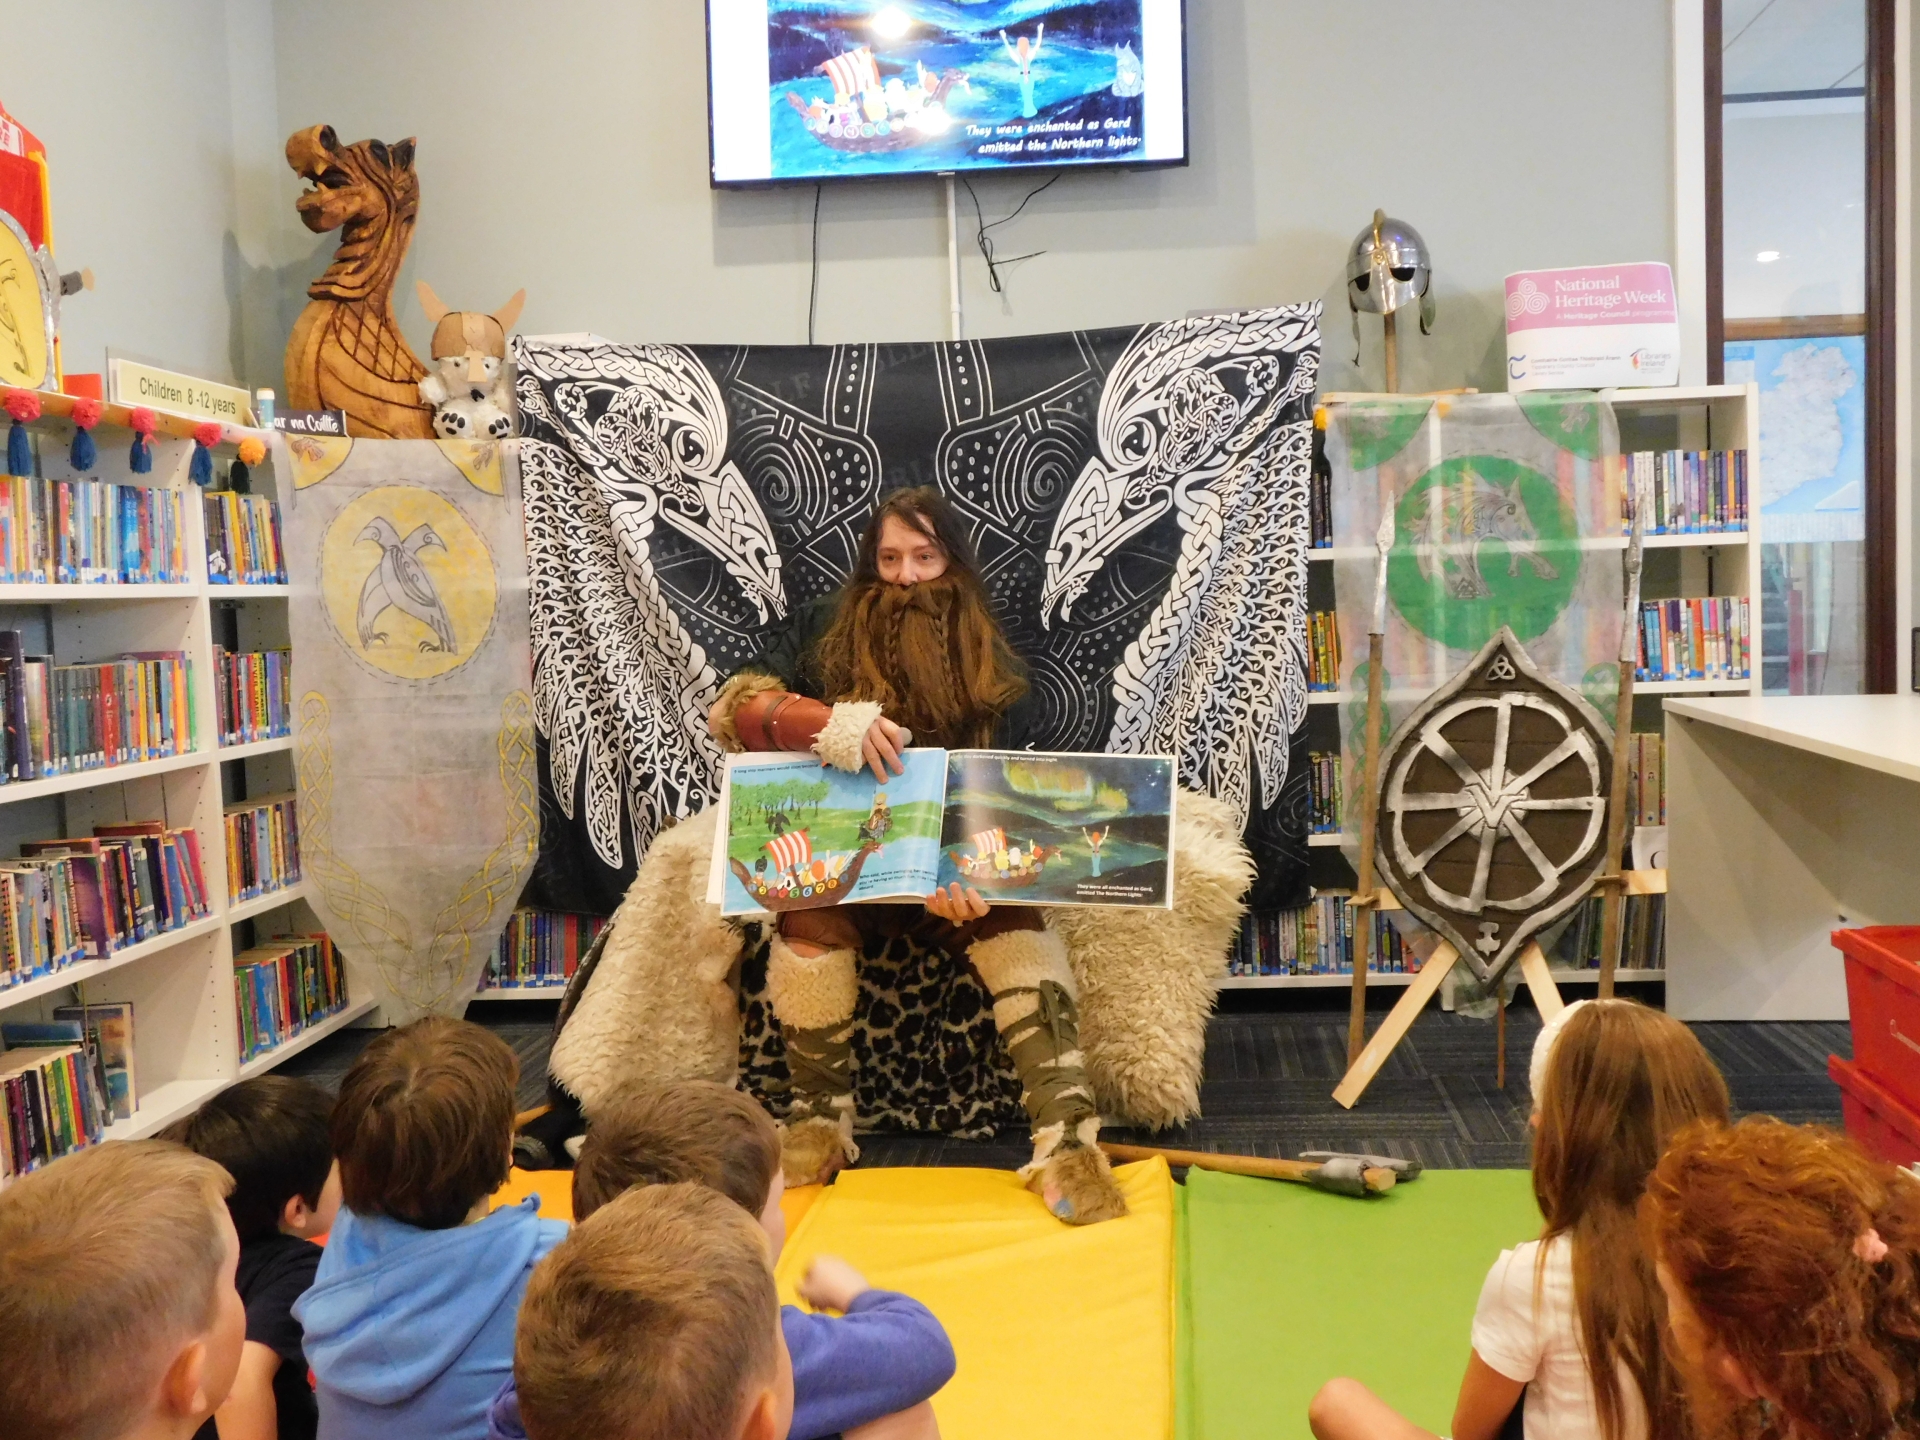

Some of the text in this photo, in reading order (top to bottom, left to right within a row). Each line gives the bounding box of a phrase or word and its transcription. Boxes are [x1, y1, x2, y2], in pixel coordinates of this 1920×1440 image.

[965, 116, 1131, 138] They were enchanted as Gerd
[978, 140, 1023, 154] emitted
[1027, 139, 1047, 151] the
[1051, 138, 1103, 150] Northern
[1555, 274, 1620, 293] National
[1555, 289, 1667, 309] Heritage Week
[1563, 312, 1598, 320] Heritage
[1600, 310, 1630, 318] Council
[1631, 310, 1675, 318] programme
[1640, 352, 1671, 360] Libraries
[140, 377, 182, 403] Children
[187, 388, 193, 405] 8
[212, 397, 236, 415] years
[290, 419, 307, 431] na
[306, 414, 339, 433] Coillte
